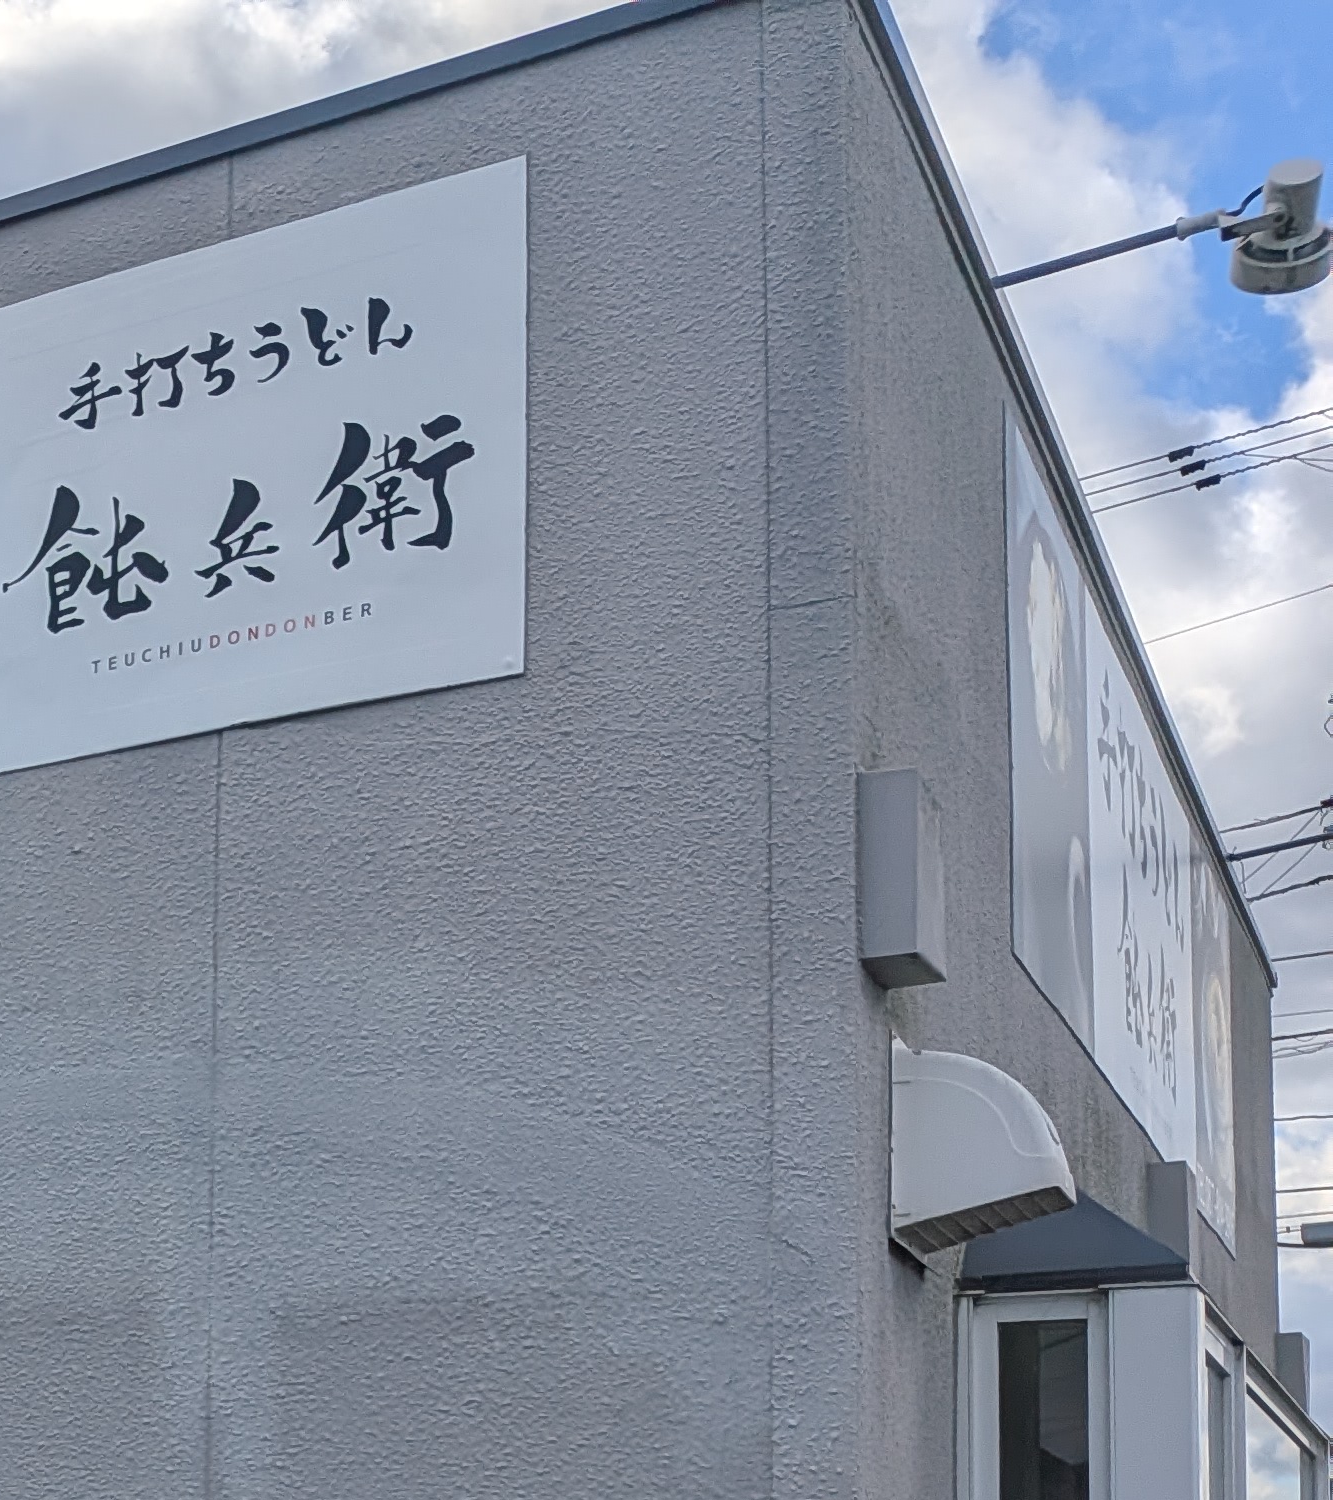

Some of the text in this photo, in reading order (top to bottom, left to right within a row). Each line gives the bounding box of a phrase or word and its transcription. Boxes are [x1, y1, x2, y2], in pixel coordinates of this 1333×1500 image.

[58, 297, 414, 430] 手打ちうどん
[2, 414, 475, 635] 飩兵衛
[91, 602, 374, 674] TEUCHIUDONDONBER
[1097, 668, 1185, 953] 手打ちうどん
